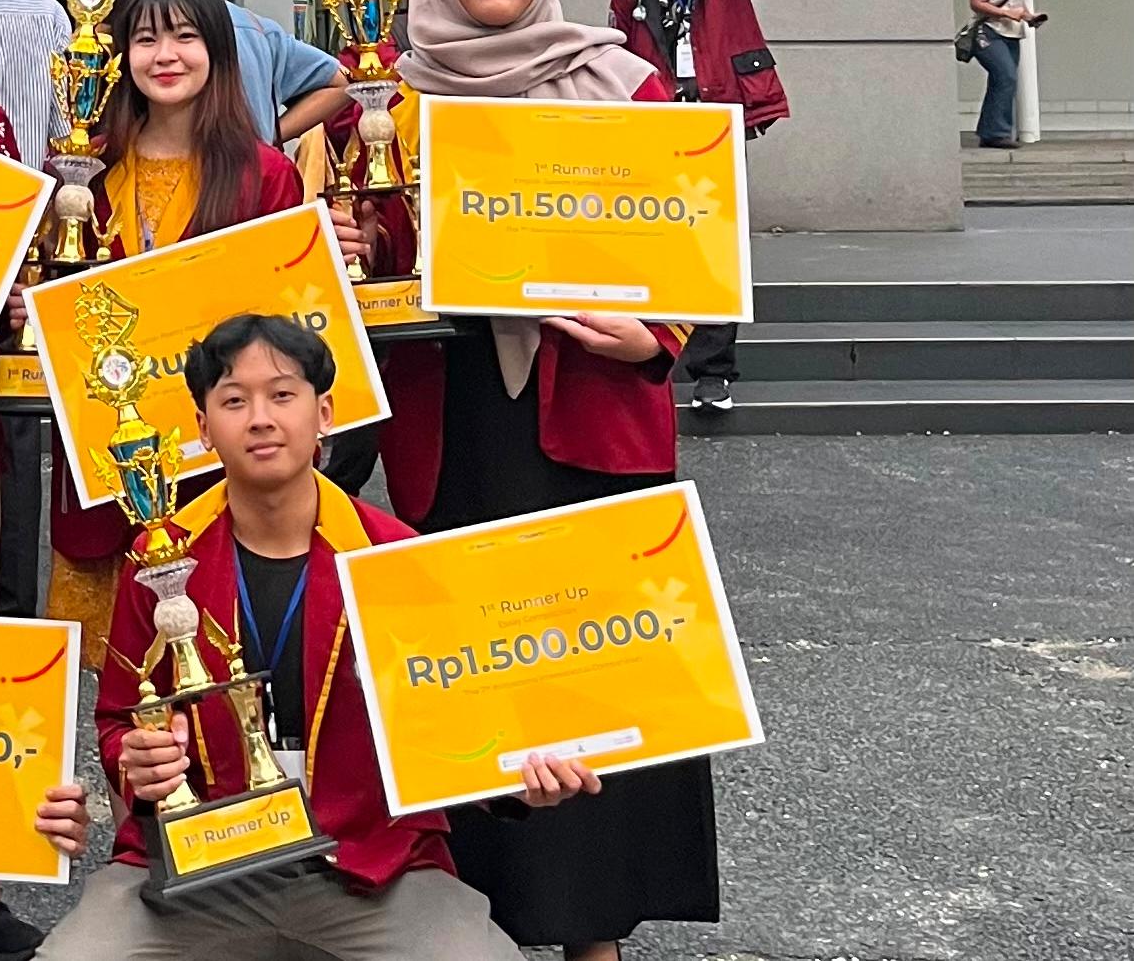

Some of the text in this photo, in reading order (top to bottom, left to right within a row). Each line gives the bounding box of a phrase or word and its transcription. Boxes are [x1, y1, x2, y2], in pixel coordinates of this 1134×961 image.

[552, 163, 607, 176] Runner
[610, 166, 631, 178] Up
[461, 190, 709, 227] Rp1.500.000,-
[406, 294, 423, 308] Up
[500, 591, 561, 615] Runner
[564, 586, 590, 601] Up
[406, 609, 686, 689] Rp1.500.000,-
[203, 816, 264, 844] Runner
[267, 810, 292, 826] Up
